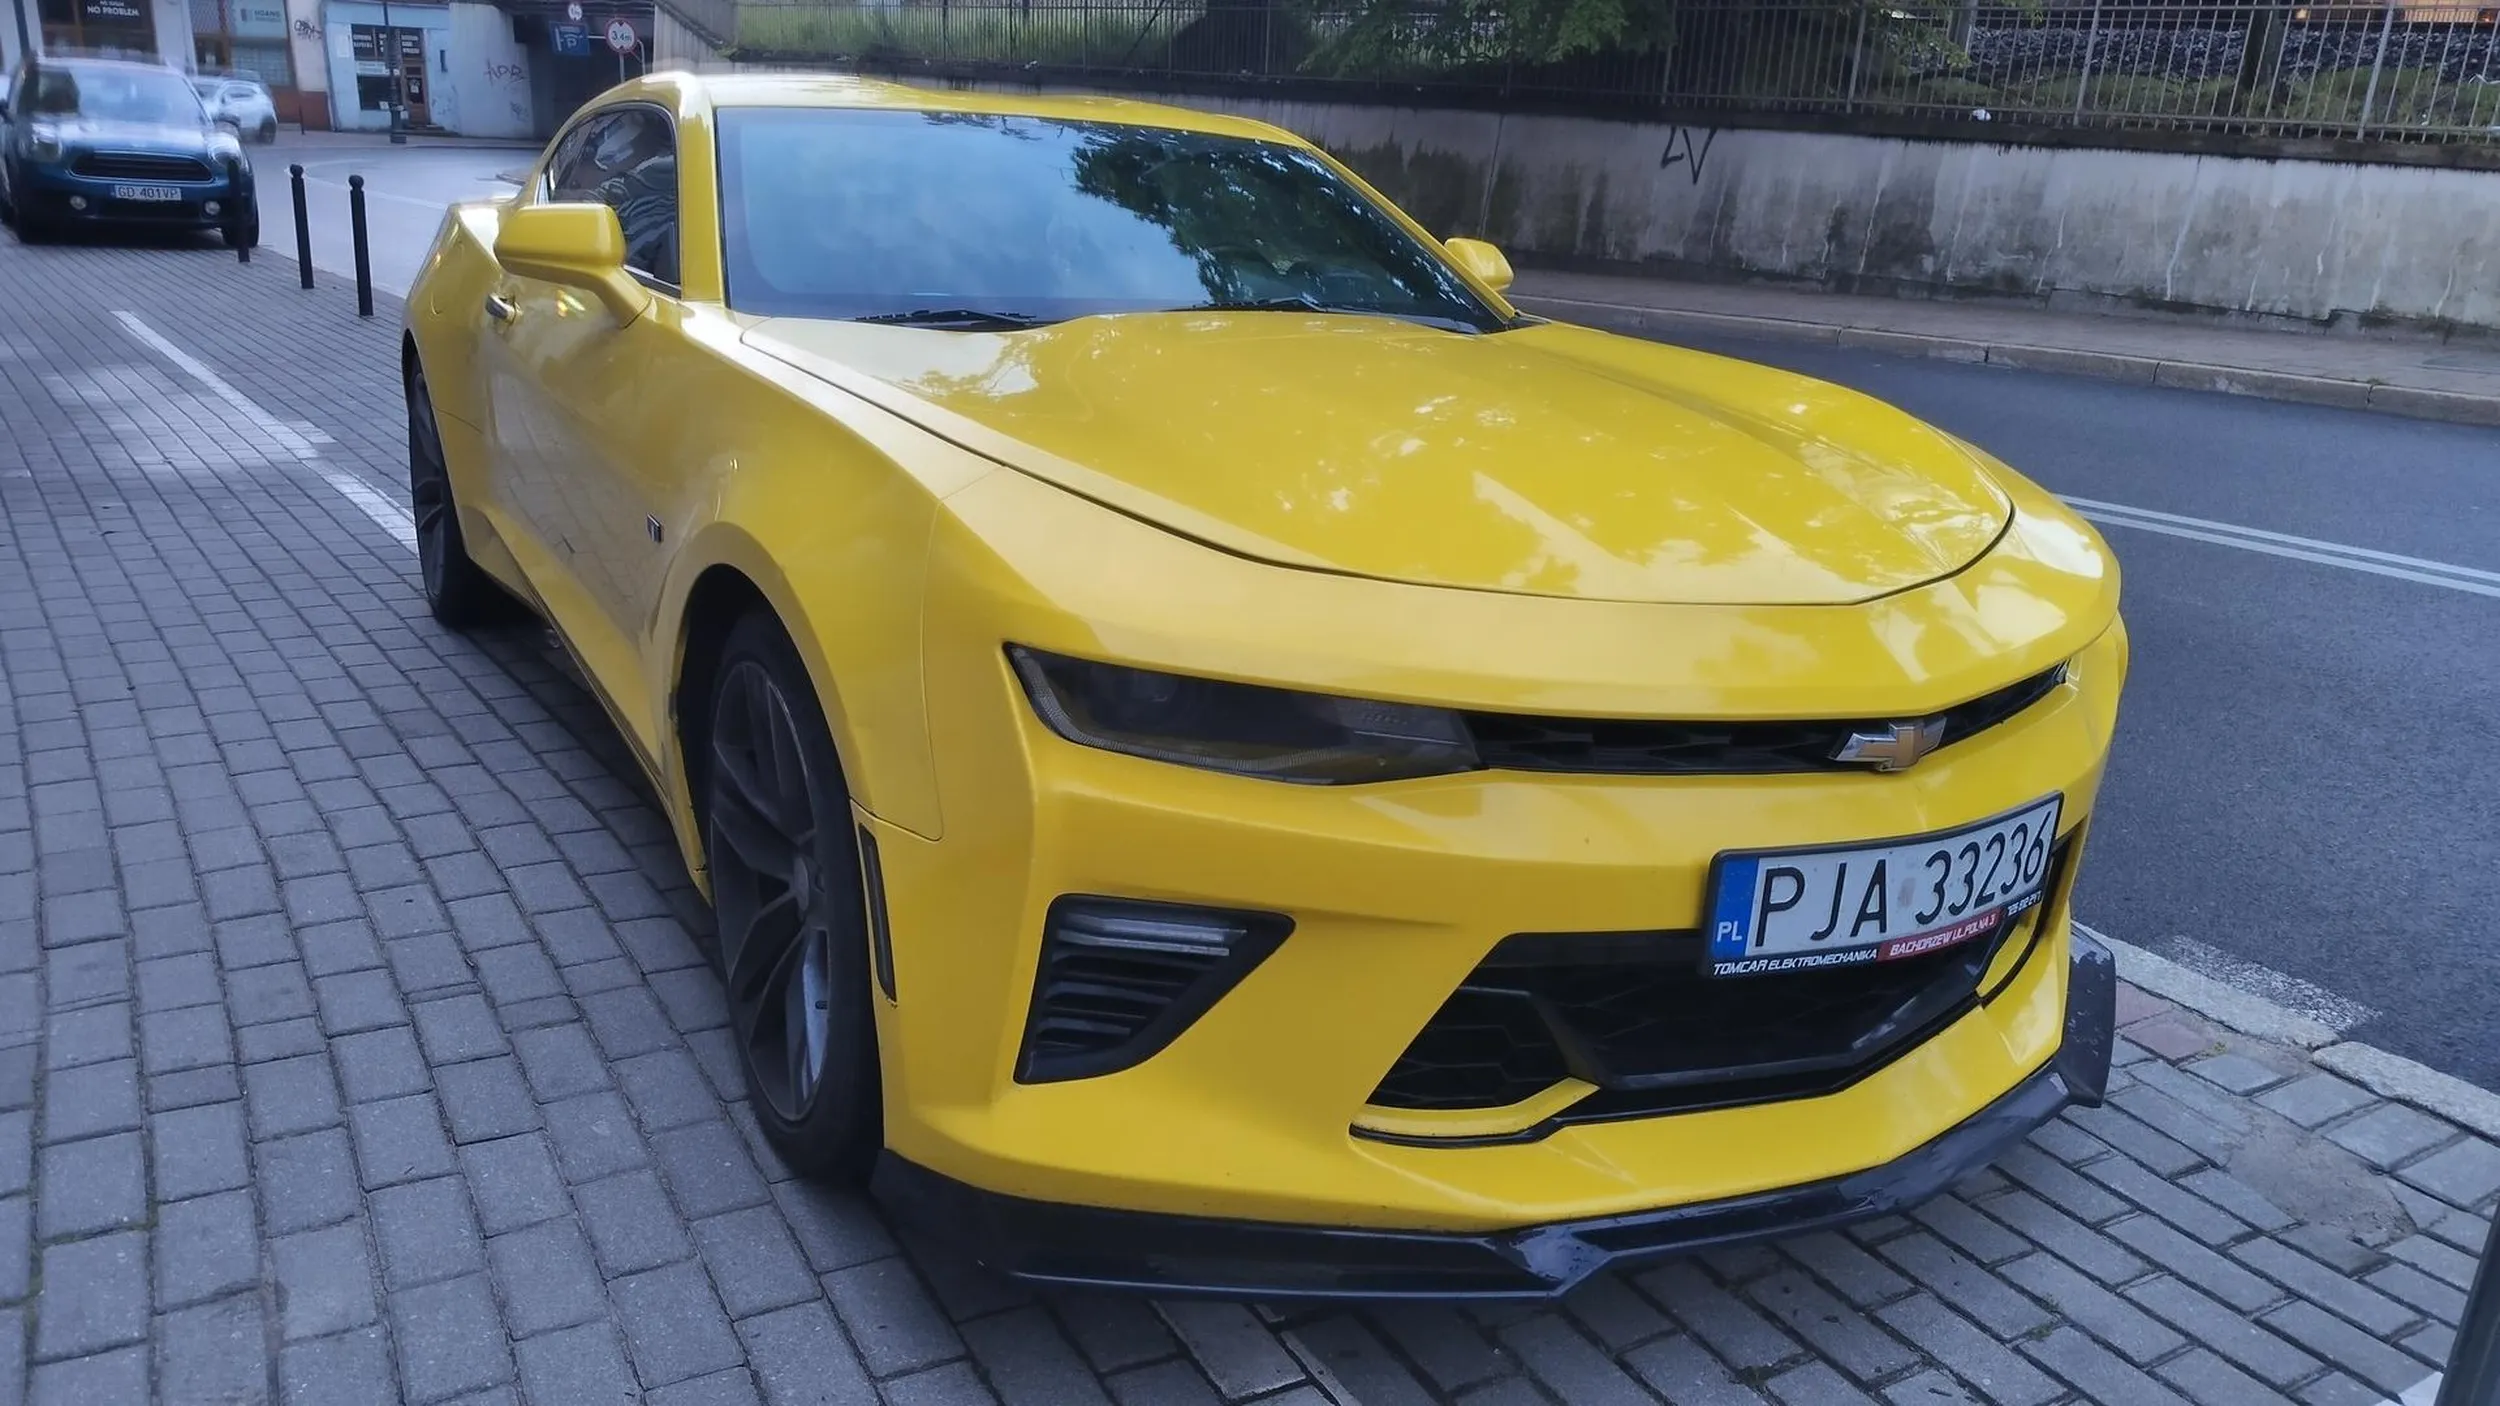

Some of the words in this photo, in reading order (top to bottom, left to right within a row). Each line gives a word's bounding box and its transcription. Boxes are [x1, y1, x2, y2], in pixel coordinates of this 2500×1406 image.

[87, 6, 100, 14] NO
[102, 6, 139, 17] PROBLEM
[118, 187, 134, 198] GD
[140, 187, 178, 199] 401VP
[1754, 859, 1887, 947] PJA
[1915, 809, 2053, 926] 33236
[1716, 921, 1743, 943] PL
[1713, 958, 1768, 976] TOMCAR
[1768, 948, 1878, 971] ELEKTROMECHANIKA
